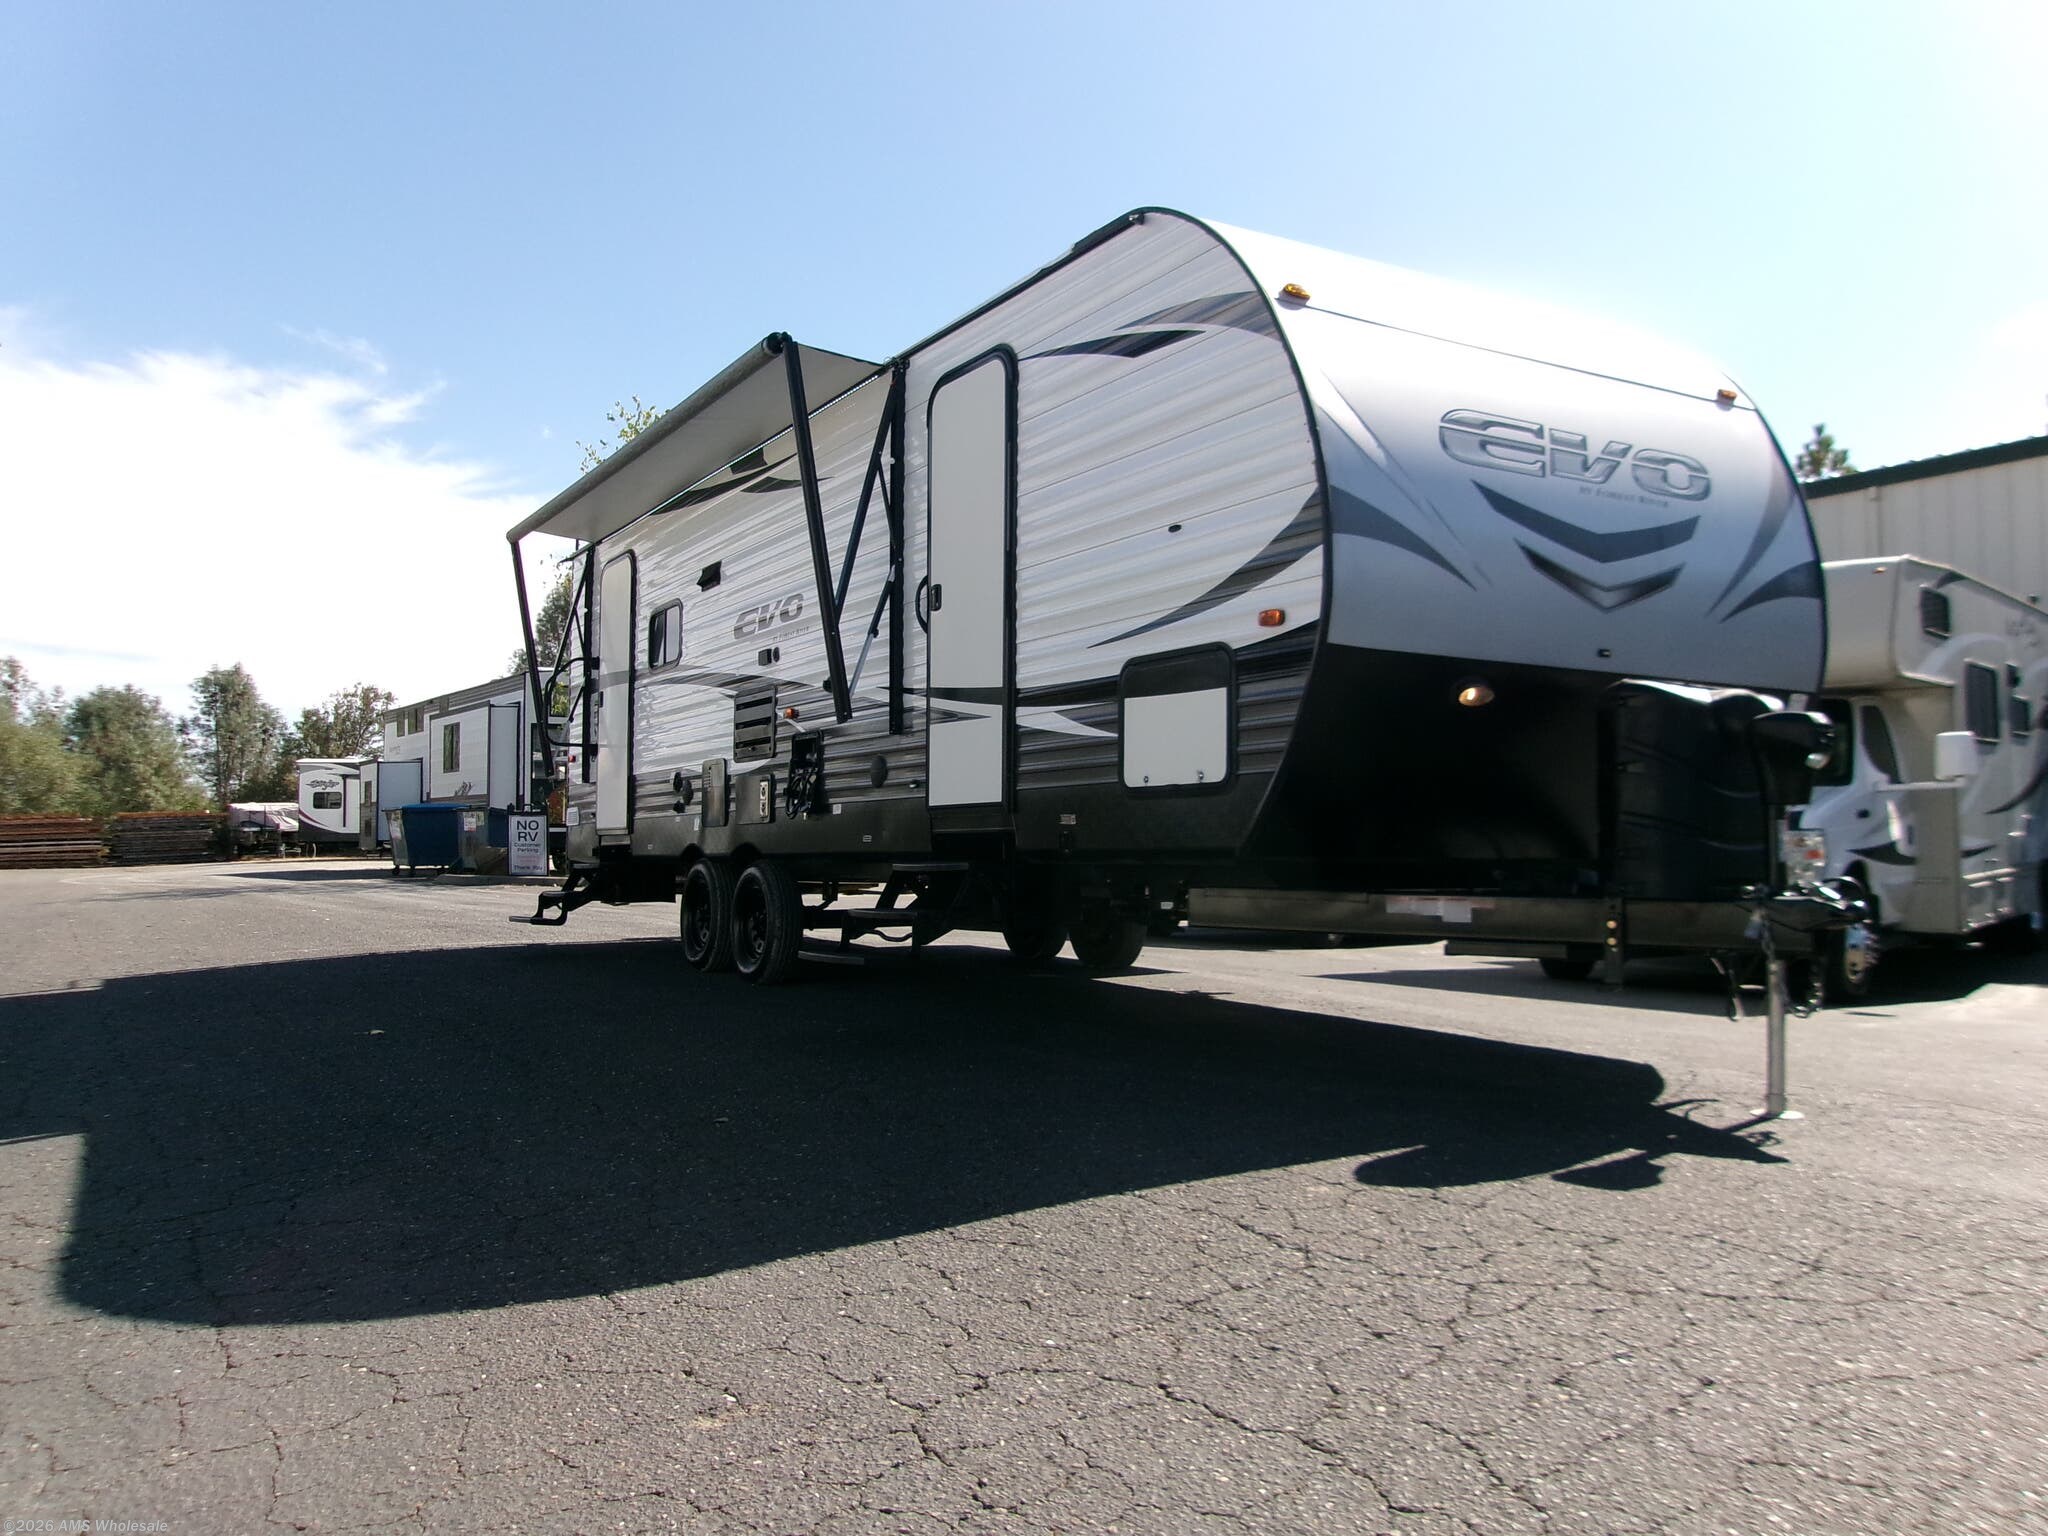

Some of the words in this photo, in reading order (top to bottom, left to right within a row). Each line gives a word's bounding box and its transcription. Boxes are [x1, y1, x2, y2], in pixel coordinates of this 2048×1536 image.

[1438, 408, 1713, 502] EVO
[734, 593, 804, 639] EVO
[517, 820, 539, 830] NO
[517, 831, 538, 841] RV
